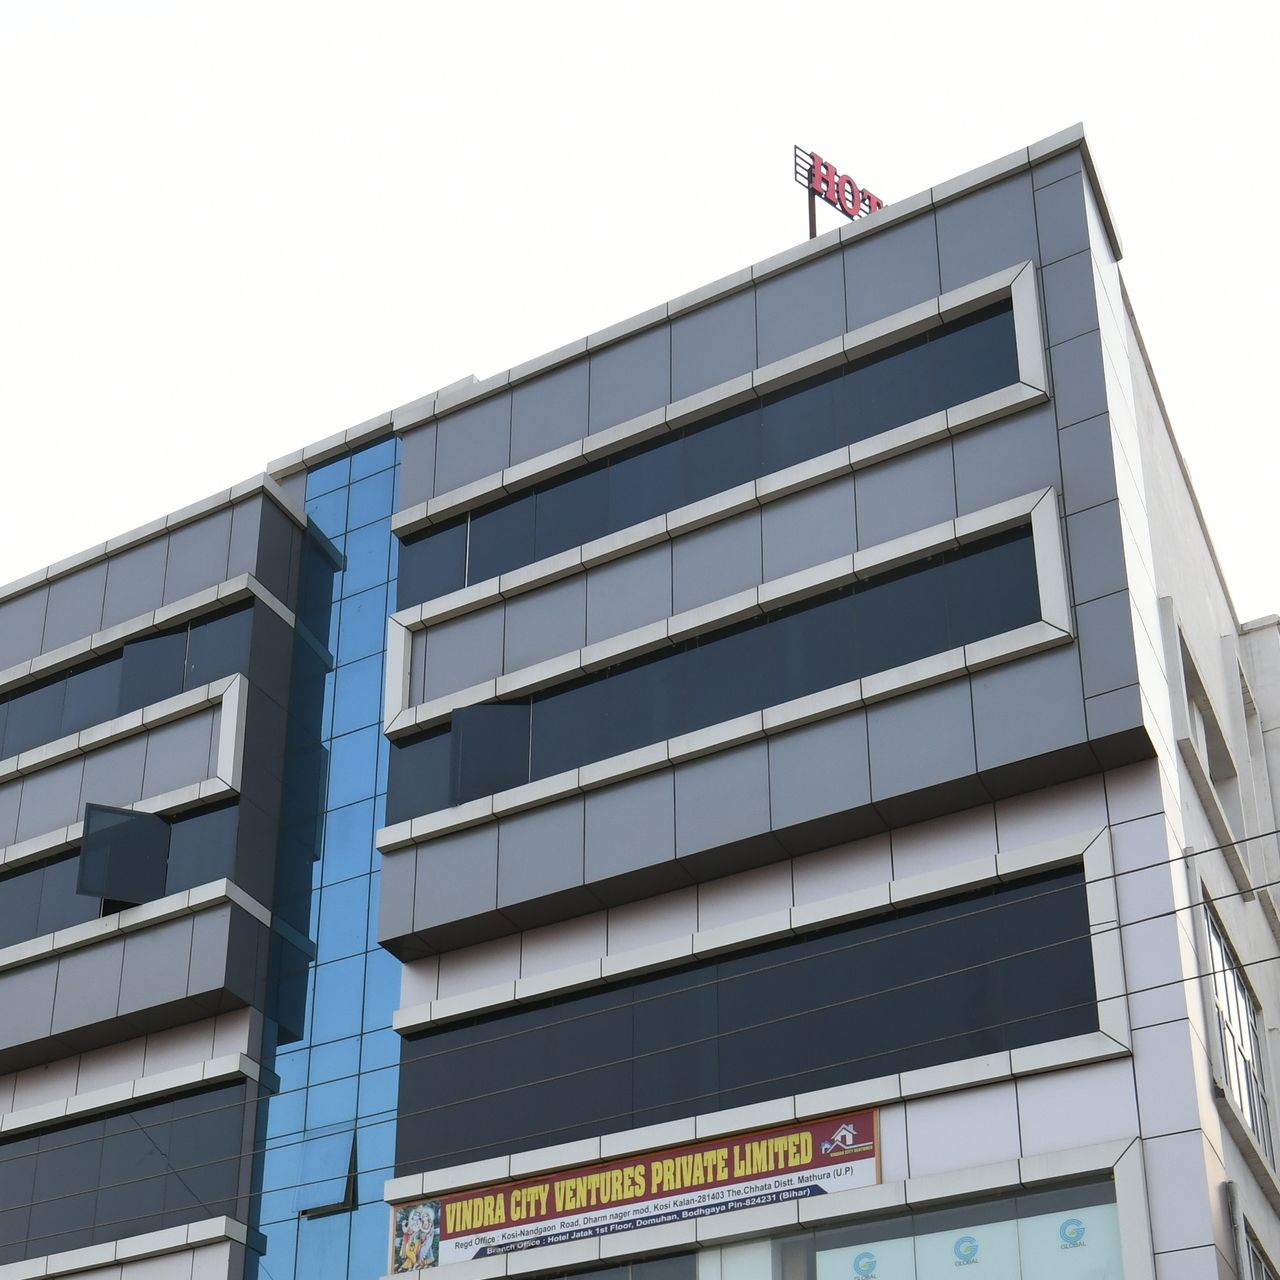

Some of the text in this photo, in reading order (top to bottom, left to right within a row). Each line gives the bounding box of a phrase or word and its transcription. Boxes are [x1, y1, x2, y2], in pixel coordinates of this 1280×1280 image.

[446, 1131, 813, 1234] VINDRA CITY VENTURES PRIVATE LIMITED
[455, 1240, 472, 1250] Regd
[474, 1235, 496, 1246] Office
[501, 1224, 556, 1241] Kosi-Nandgaon
[583, 1215, 608, 1225] Dharm
[609, 1211, 631, 1222] nager
[653, 1202, 671, 1212] Kosi
[673, 1189, 725, 1208] Kalan-281403
[797, 1172, 831, 1184] Mathura
[547, 1233, 569, 1244] Hotel
[571, 1229, 593, 1239] Jatak
[595, 1226, 608, 1235] 1st
[610, 1221, 634, 1232] Floor,
[636, 1213, 680, 1227] Domuhan,
[681, 1204, 725, 1219] Bodhgaya
[779, 1188, 811, 1201] (Bihar)
[954, 1258, 980, 1268] GLOBAL
[1060, 1241, 1087, 1250] GLOBAL
